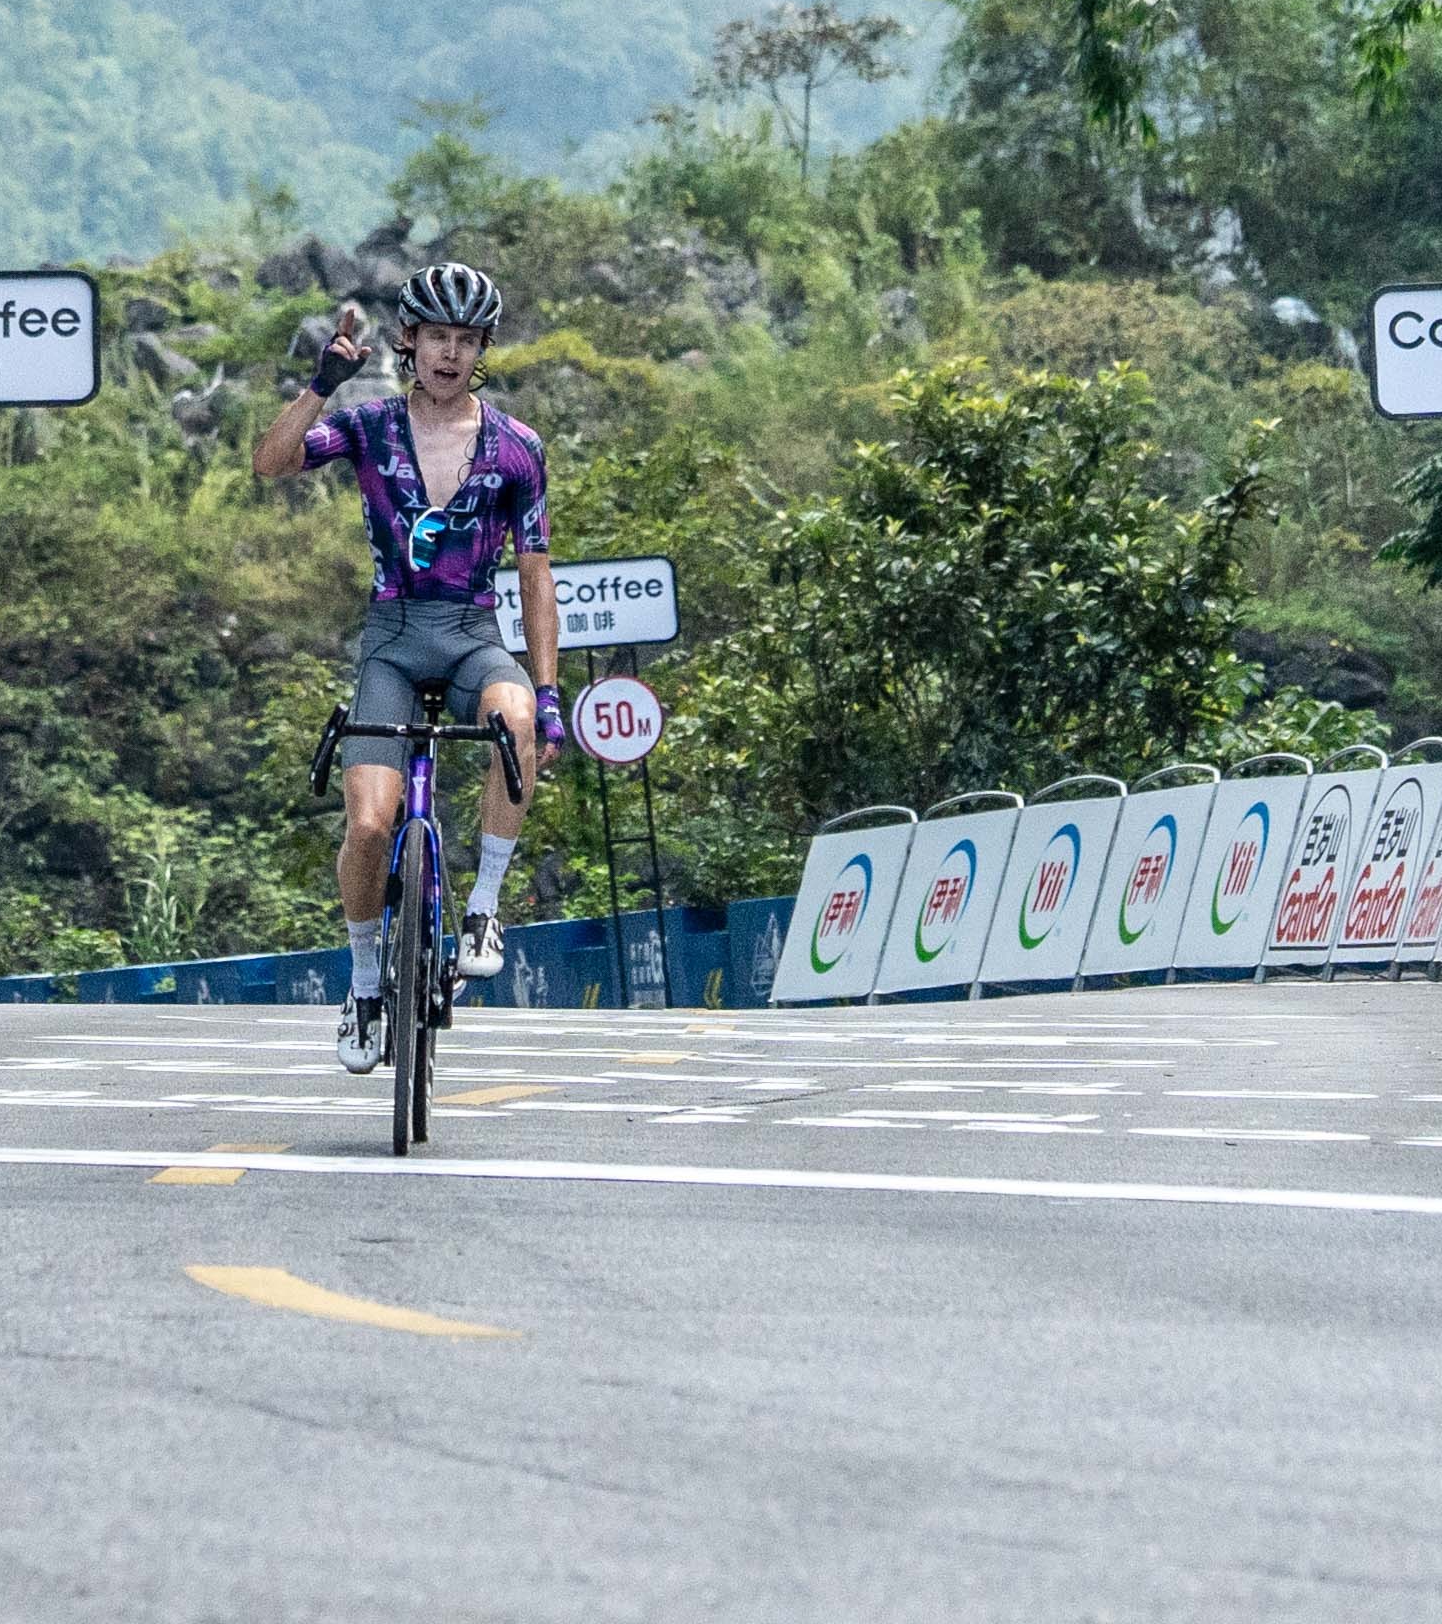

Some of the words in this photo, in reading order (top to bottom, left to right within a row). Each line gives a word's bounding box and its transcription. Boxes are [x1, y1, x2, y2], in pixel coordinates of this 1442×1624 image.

[555, 575, 664, 605] Coffee
[594, 700, 652, 740] 50M
[1032, 861, 1068, 914] Yili
[1127, 852, 1170, 906] 伊利
[1223, 840, 1258, 897] Yili
[818, 889, 865, 939] 伊利
[923, 875, 969, 927] 伊利
